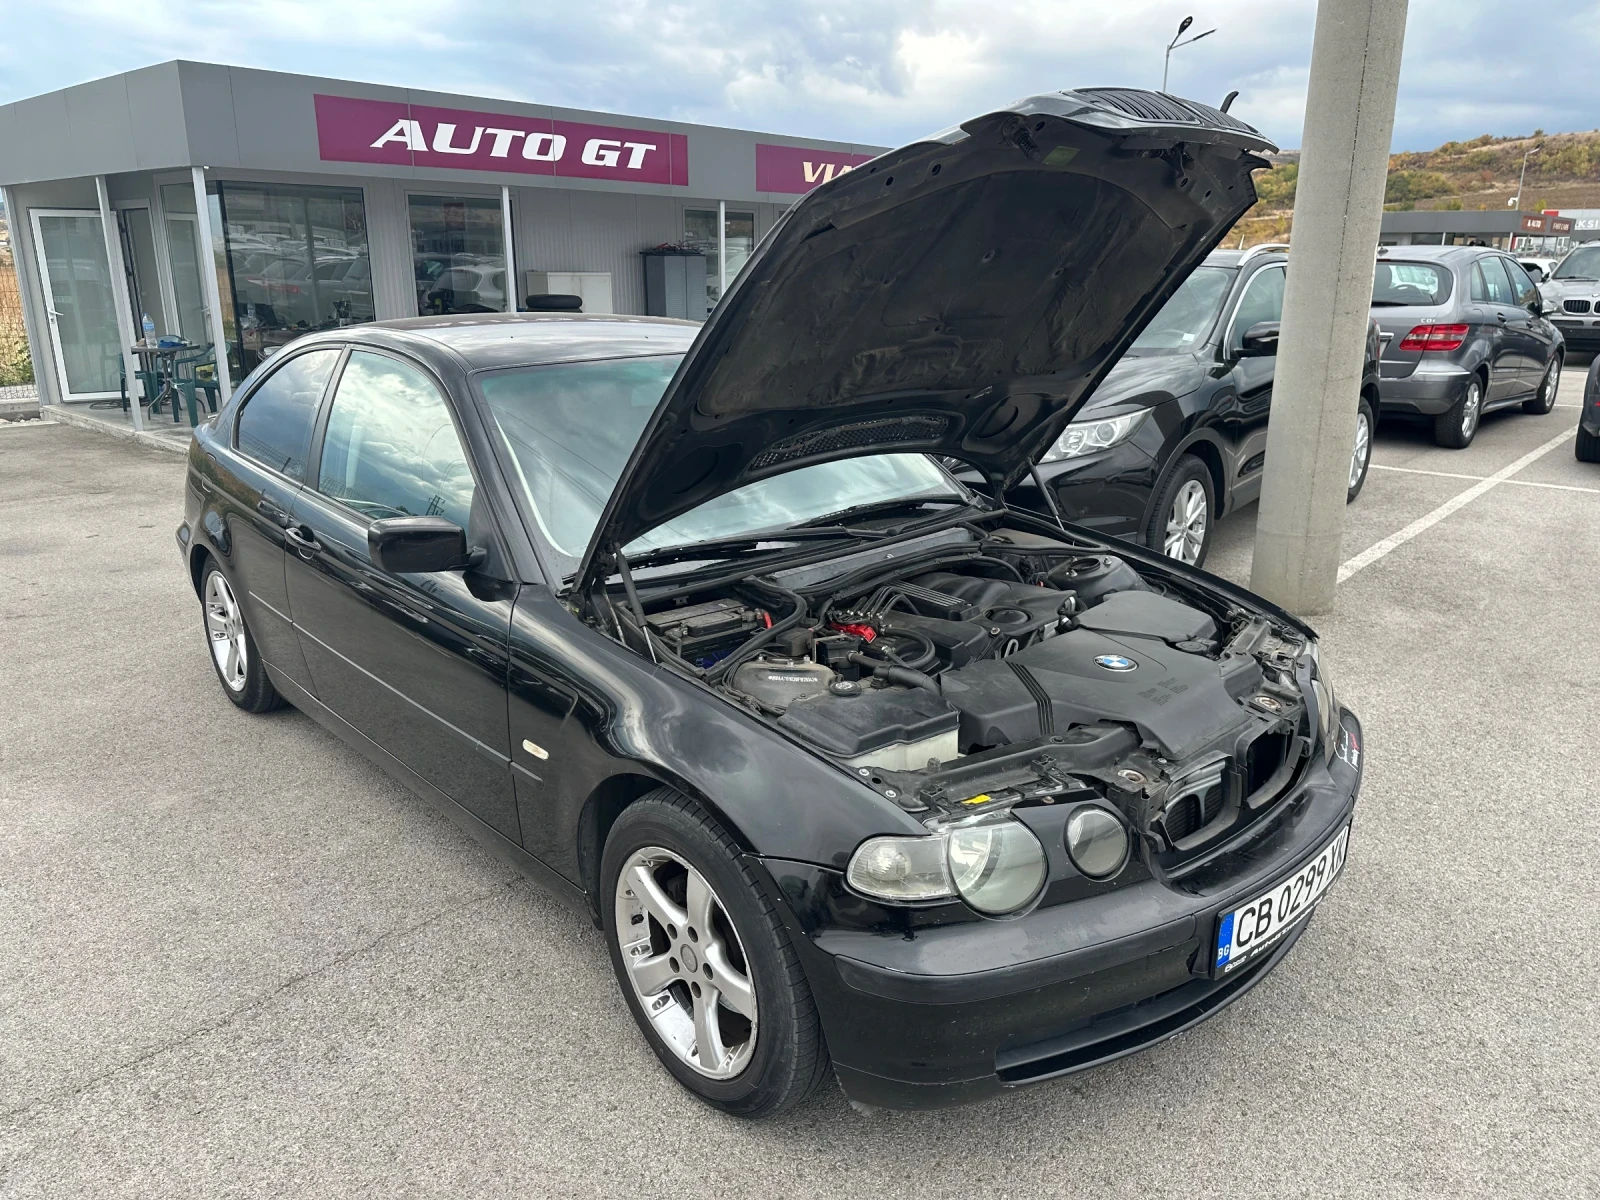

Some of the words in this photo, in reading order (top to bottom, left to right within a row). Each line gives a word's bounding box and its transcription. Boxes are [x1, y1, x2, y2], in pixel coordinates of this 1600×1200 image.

[369, 119, 567, 162] AUTO
[581, 138, 657, 169] GT
[1236, 898, 1273, 948] CB
[1278, 855, 1327, 923] 0299
[1217, 944, 1230, 960] BG
